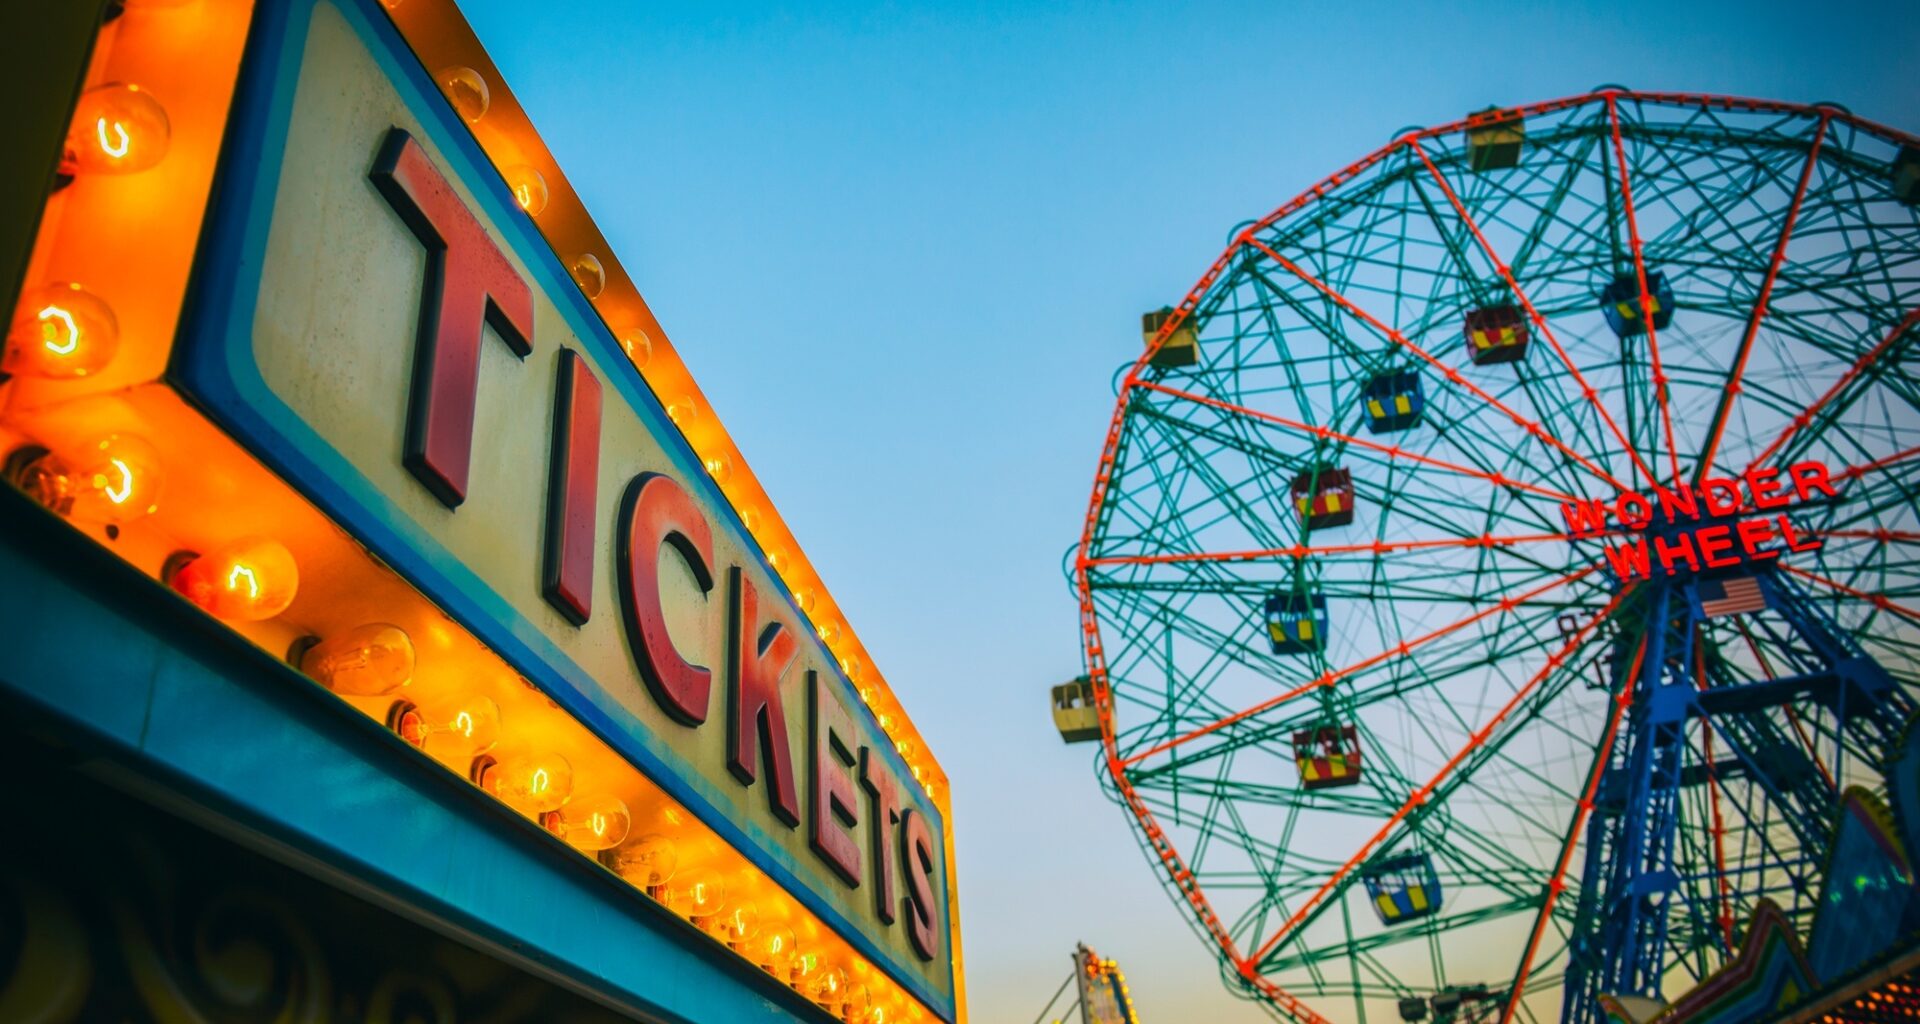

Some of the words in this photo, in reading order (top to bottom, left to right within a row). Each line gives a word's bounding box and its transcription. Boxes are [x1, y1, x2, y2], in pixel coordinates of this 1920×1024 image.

[1561, 461, 1836, 538] WONDER
[369, 126, 939, 961] TICKETS
[1604, 514, 1822, 583] WHEEL
